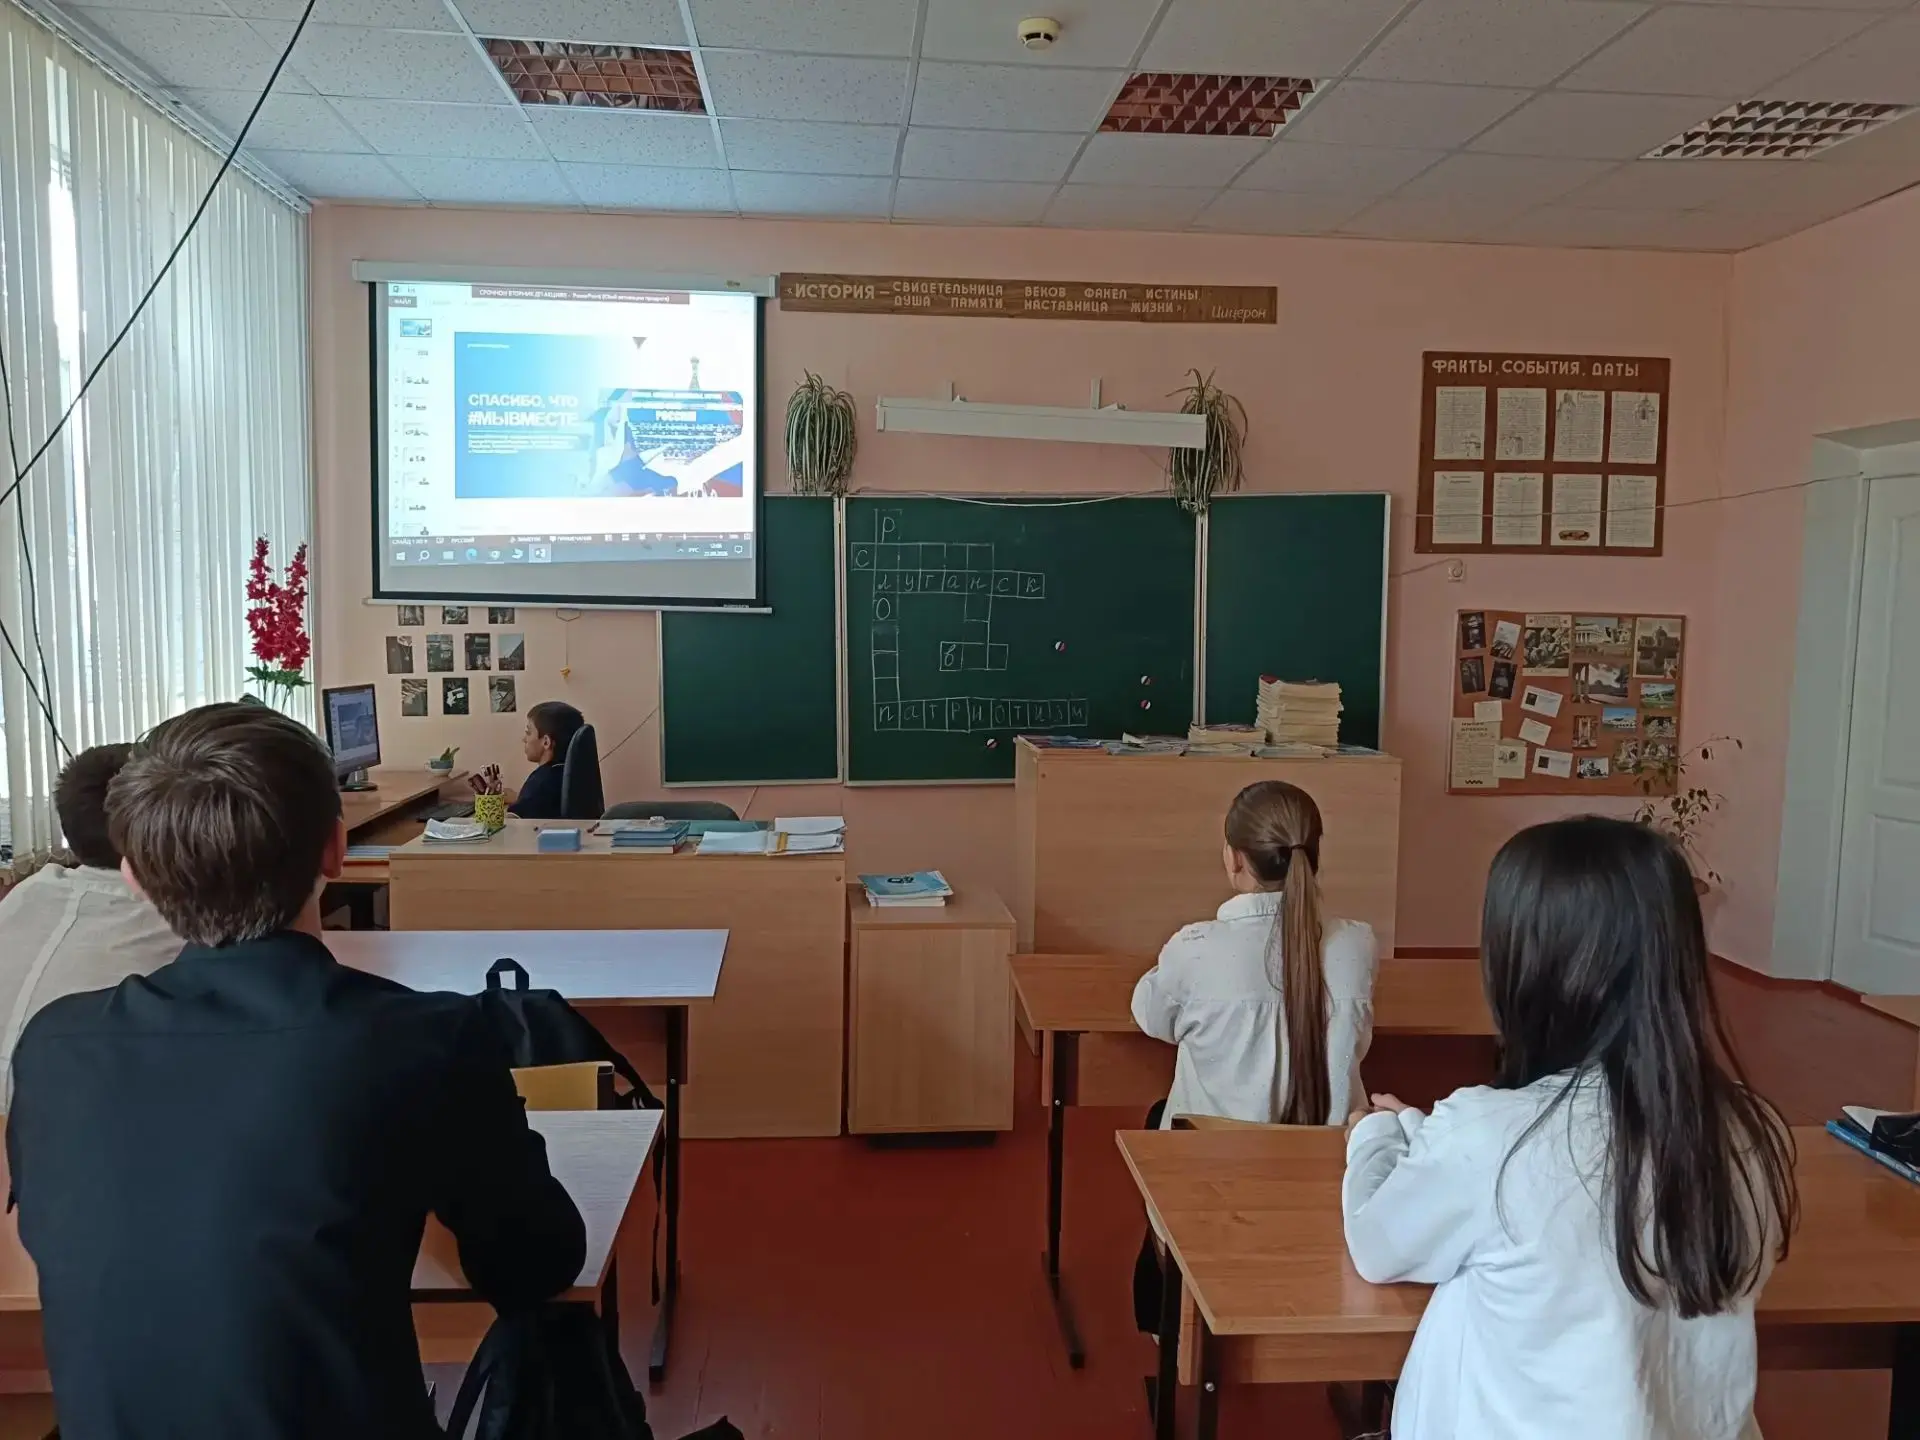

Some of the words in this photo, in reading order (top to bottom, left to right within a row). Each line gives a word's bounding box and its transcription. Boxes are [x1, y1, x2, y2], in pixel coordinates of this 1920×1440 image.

[892, 281, 1003, 296] СВИДЕТЕЛЬНИЦА
[1024, 286, 1067, 298] ВЕКОВ
[1084, 287, 1128, 300] ФАКЕЛ
[894, 295, 930, 307] ДУША
[1024, 299, 1108, 313] НАСТАВНИЦА
[1211, 306, 1268, 324] Цицерон
[1591, 362, 1639, 377] ДАТЫ
[468, 393, 546, 409] СПАСИБО,
[548, 394, 580, 408] ЧТО
[468, 411, 579, 427] #МЫВМЕСТЕ
